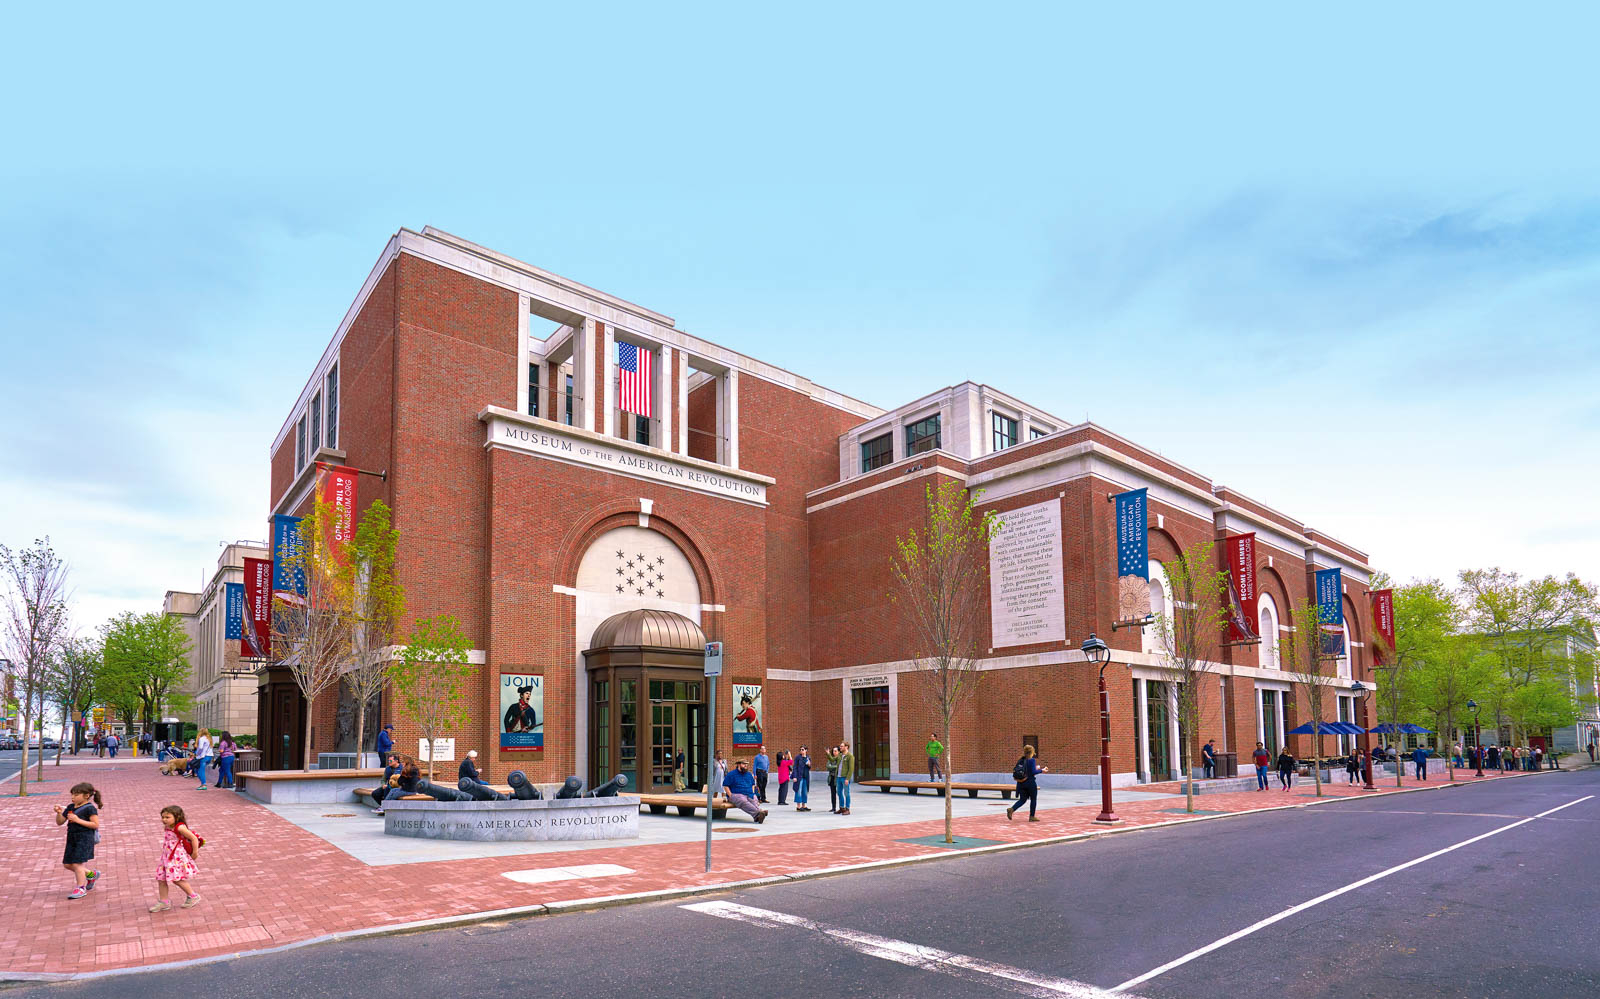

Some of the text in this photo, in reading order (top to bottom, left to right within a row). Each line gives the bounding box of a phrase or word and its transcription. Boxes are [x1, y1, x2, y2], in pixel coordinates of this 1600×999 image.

[505, 427, 760, 496] MUSEUM OF THE AMERICAN REVOLUTION
[336, 477, 344, 486] 19
[1040, 588, 1056, 596] powers
[504, 676, 538, 688] JOIN
[736, 686, 758, 696] VISIT
[393, 820, 436, 830] MUSEUM
[477, 818, 543, 830] AMERICAN
[551, 814, 629, 827] REVOLUTION
